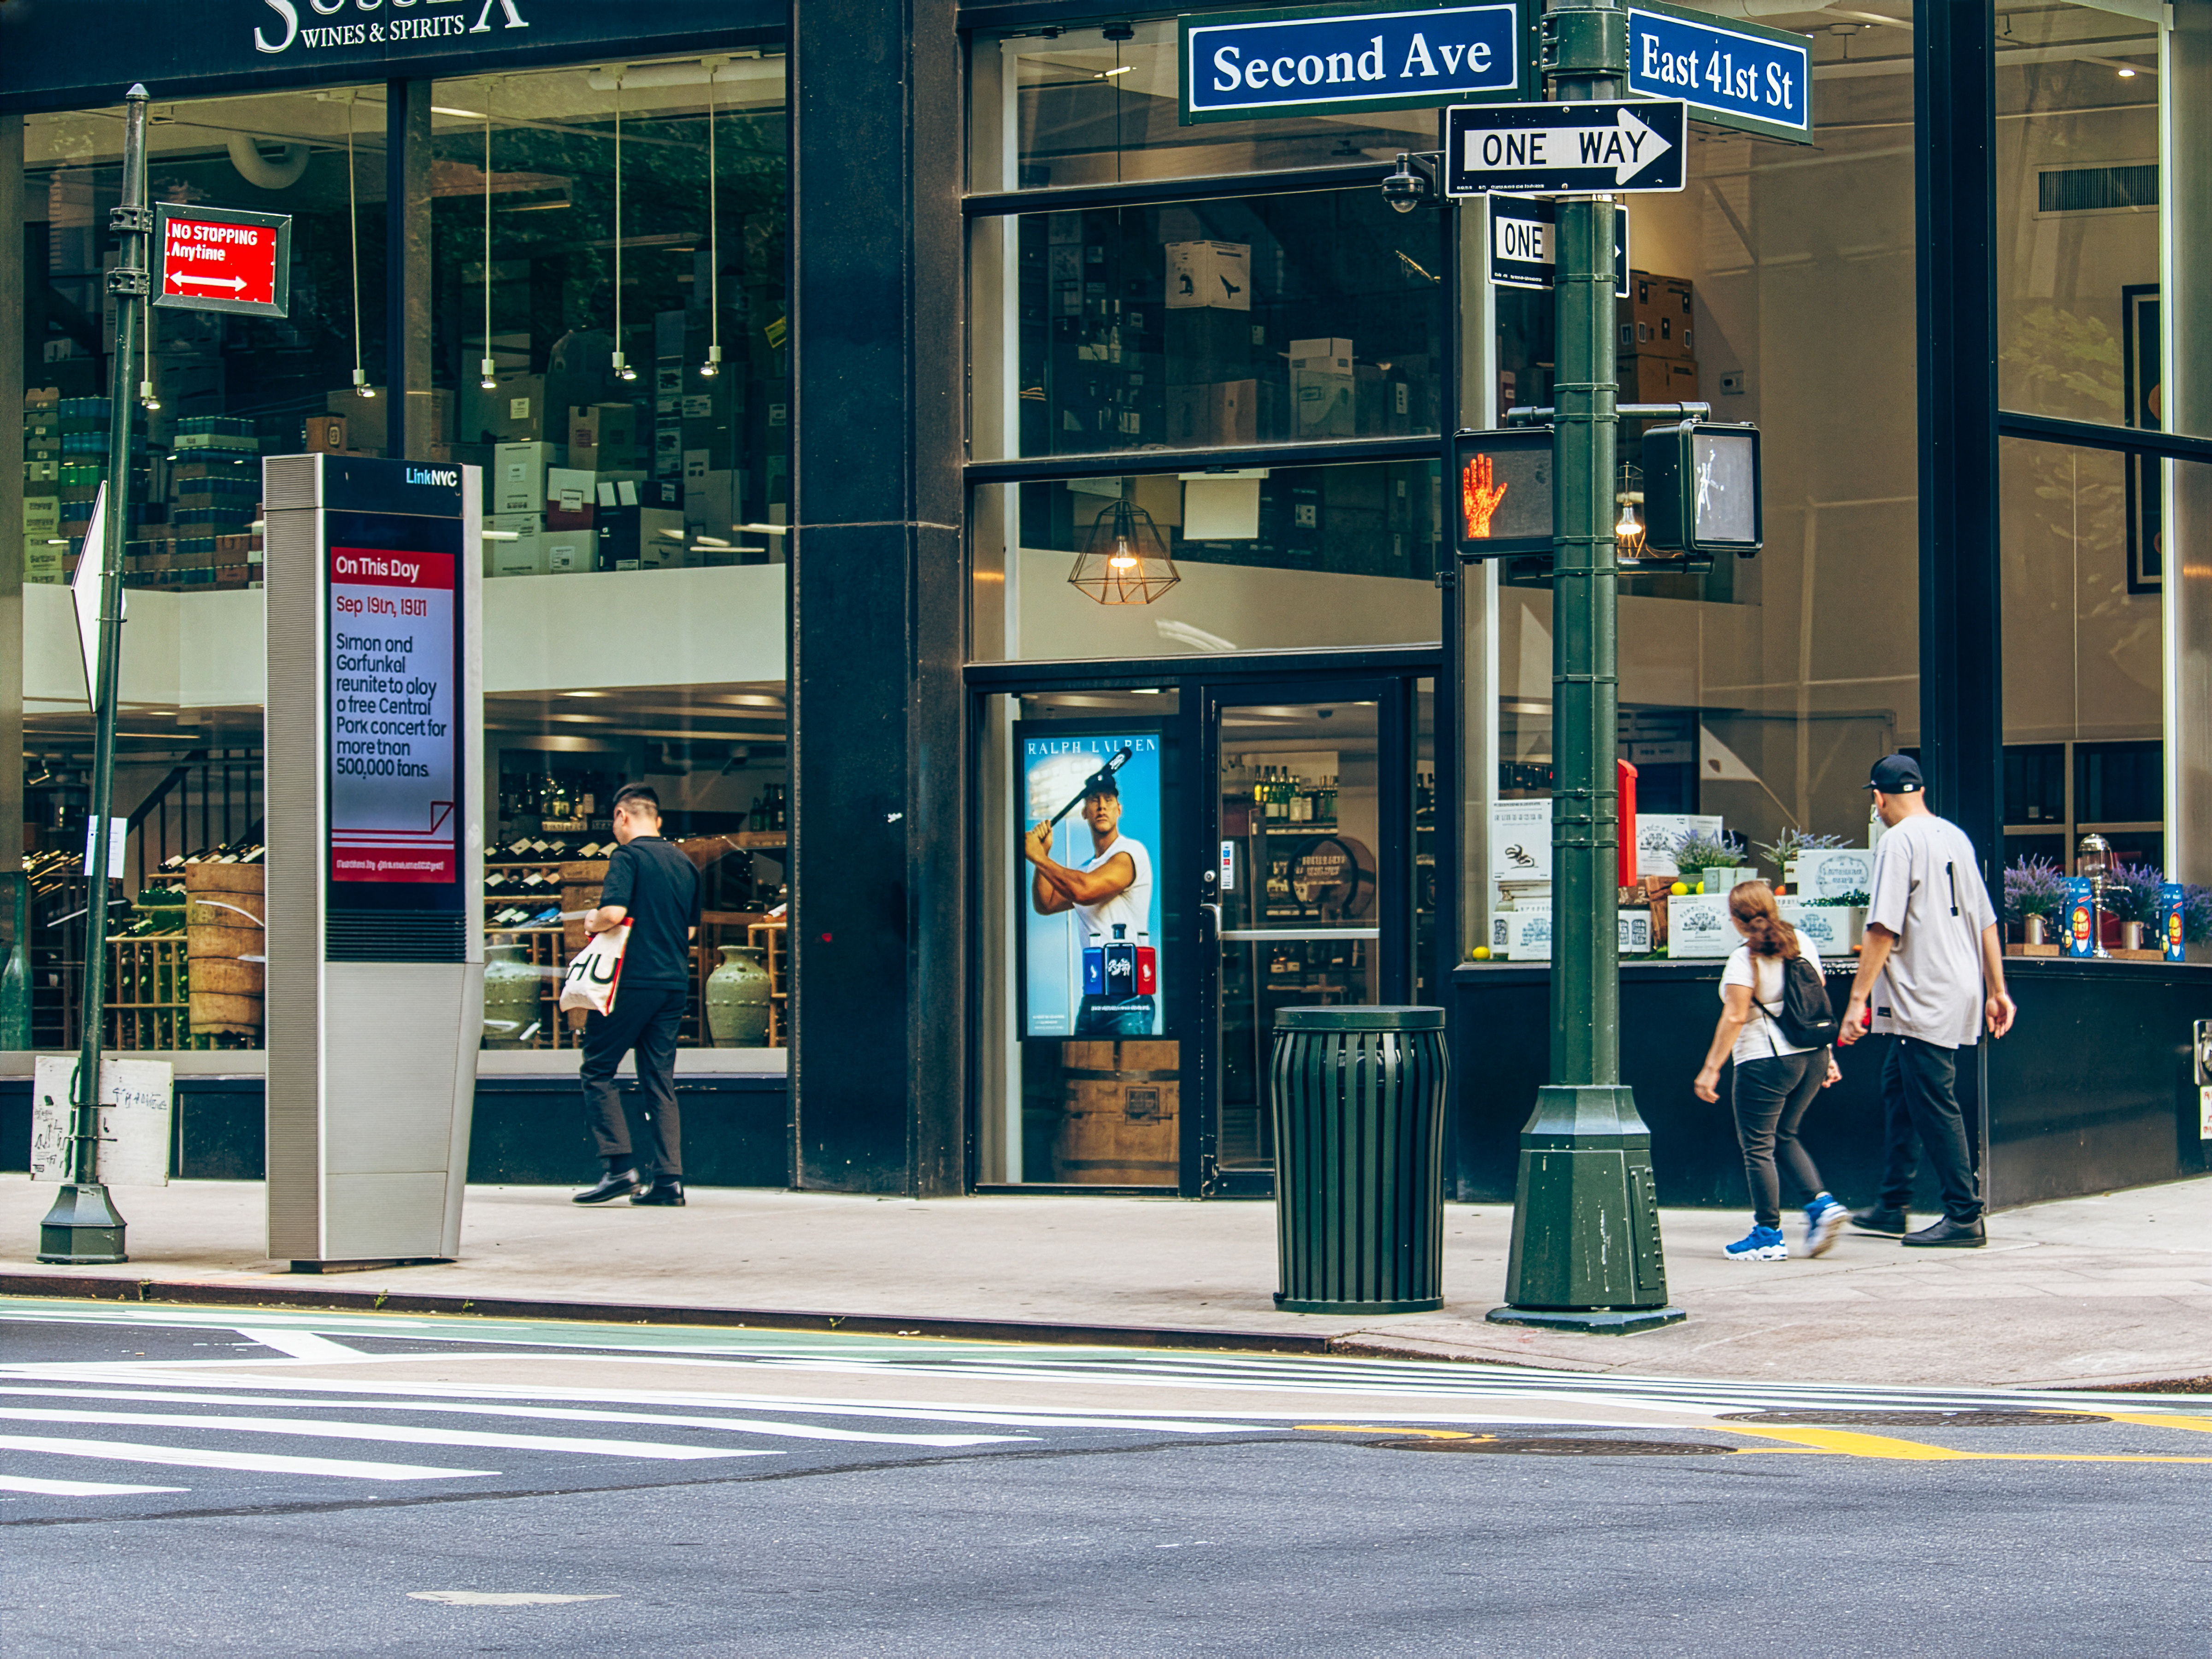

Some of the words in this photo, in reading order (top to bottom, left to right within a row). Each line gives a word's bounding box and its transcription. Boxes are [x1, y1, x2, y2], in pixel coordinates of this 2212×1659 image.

[300, 24, 365, 48] WINES
[369, 23, 386, 42] &
[390, 15, 464, 41] SPIRITS
[1213, 35, 1386, 91] Second
[1400, 33, 1492, 78] Ave
[1641, 33, 1699, 88] East
[1705, 50, 1759, 102] 41st
[1766, 62, 1793, 110] St
[1483, 133, 1547, 166] ONE
[1579, 130, 1647, 164] WAY
[171, 223, 192, 240] NO
[194, 225, 258, 246] STOPPING
[1505, 223, 1544, 259] ONE
[171, 241, 226, 262] Anytime
[406, 467, 457, 487] LinkNYC
[335, 556, 357, 575] On
[359, 557, 388, 576] This
[391, 559, 420, 583] Day
[336, 595, 363, 618] Sep
[336, 632, 382, 652] Simon
[385, 635, 413, 653] and
[336, 674, 387, 693] reunite
[389, 677, 403, 694] to
[347, 695, 376, 713] free
[379, 697, 431, 715] Central
[336, 716, 368, 734] Park
[370, 719, 426, 736] concert
[427, 718, 447, 737] for
[336, 740, 375, 755] more
[377, 738, 411, 756] than
[1028, 741, 1081, 755] RALPH
[336, 758, 394, 780] 500,000
[1946, 861, 1959, 917] 1
